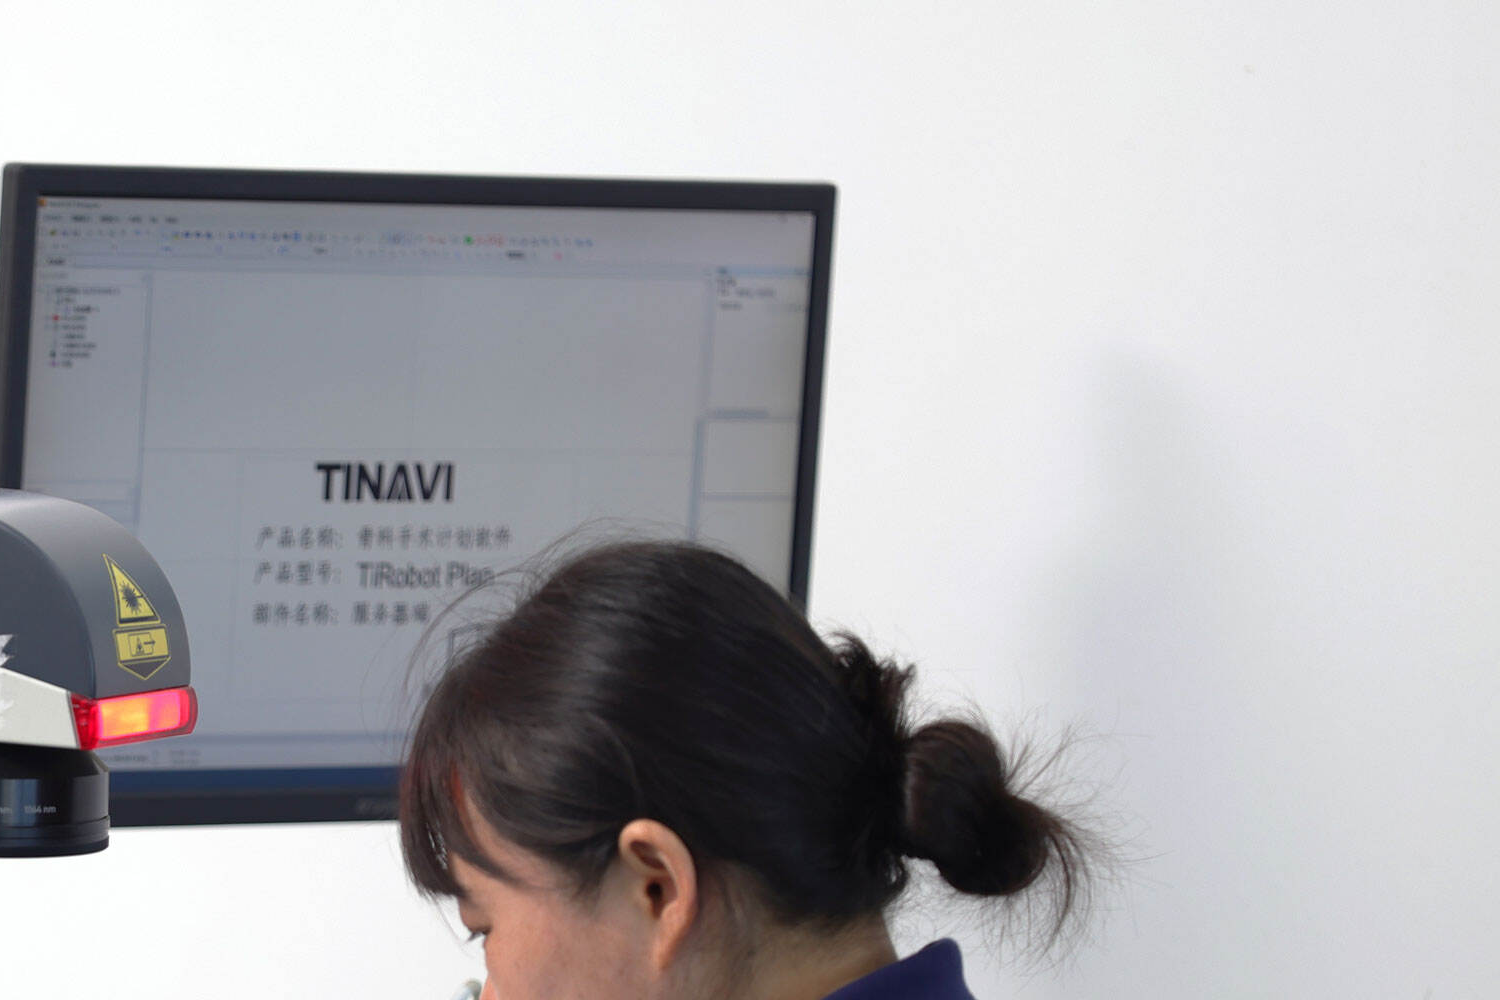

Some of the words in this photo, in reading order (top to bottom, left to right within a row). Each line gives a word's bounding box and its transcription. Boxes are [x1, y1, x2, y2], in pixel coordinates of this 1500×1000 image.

[316, 462, 455, 502] TINAVI
[357, 560, 442, 588] TiRobot
[446, 560, 495, 588] Plan
